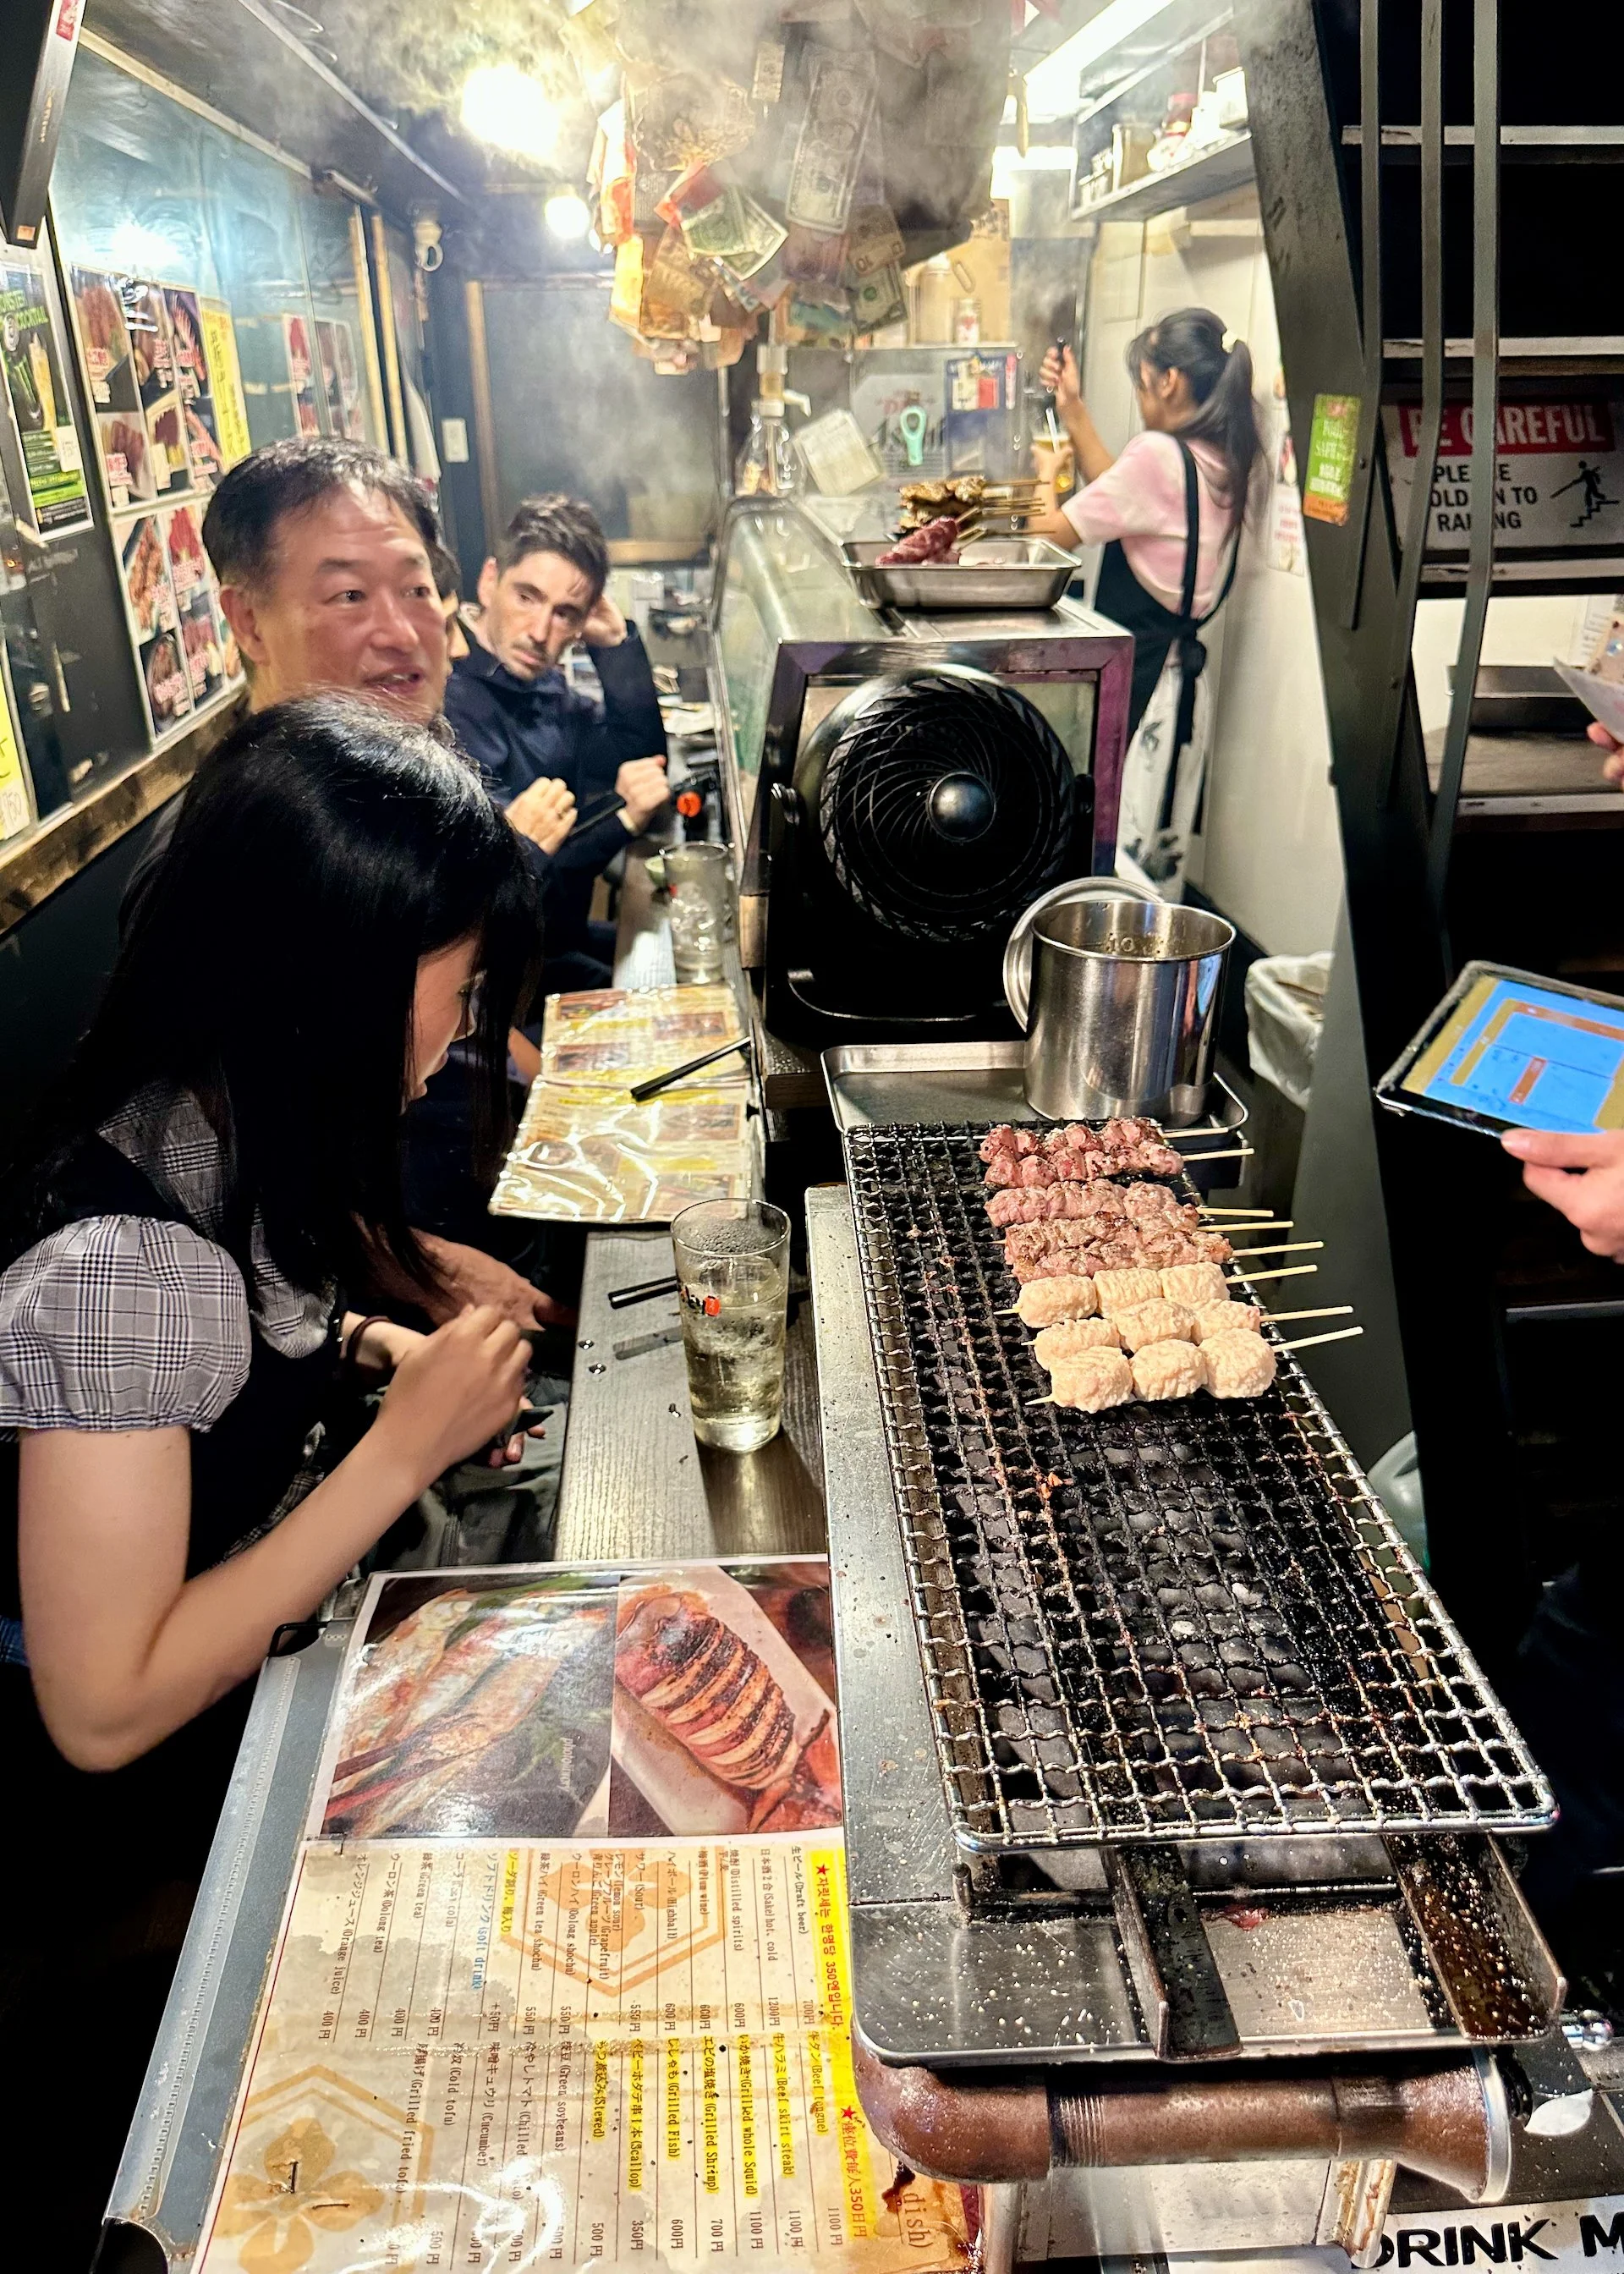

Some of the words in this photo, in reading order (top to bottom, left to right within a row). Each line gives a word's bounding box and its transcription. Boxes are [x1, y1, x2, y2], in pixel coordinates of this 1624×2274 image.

[1433, 464, 1512, 484] PLEE
[1430, 489, 1468, 508] OLD
[1511, 486, 1538, 505] TO
[1438, 511, 1522, 533] RAING
[413, 1902, 425, 1919] tea)
[699, 1893, 710, 1915] wine)
[817, 1876, 831, 1919] 자릿세는
[445, 1905, 457, 1927] cola)
[535, 1920, 545, 1934] tea
[611, 1909, 623, 1931] sour)
[797, 1912, 809, 1935] beer)
[372, 1936, 385, 1953] tea)
[589, 1919, 601, 1946] apple)
[732, 1915, 744, 1951] spirits)
[820, 1924, 836, 1956] 한명당
[531, 1938, 544, 1971] shochu)
[565, 1942, 577, 1976] shochu)
[766, 1941, 778, 1961] cold
[330, 1966, 344, 1995] juice)
[472, 1957, 487, 1990] drink)
[734, 2003, 746, 2028] 600円
[767, 1997, 782, 2026] 1200円
[802, 2000, 815, 2025] 700円
[443, 2100, 457, 2126] tofu)
[778, 2108, 790, 2136] skirt
[814, 2095, 829, 2134] tongue)
[399, 2130, 416, 2159] fried
[668, 2130, 680, 2157] Fish)
[743, 2127, 754, 2156] whole
[704, 2152, 719, 2191] Shrimp)
[782, 2142, 794, 2176] steak)
[744, 2161, 758, 2195] Squid)
[630, 2220, 645, 2250] 350円
[670, 2218, 683, 2249] 600円
[903, 2193, 934, 2249] dish)
